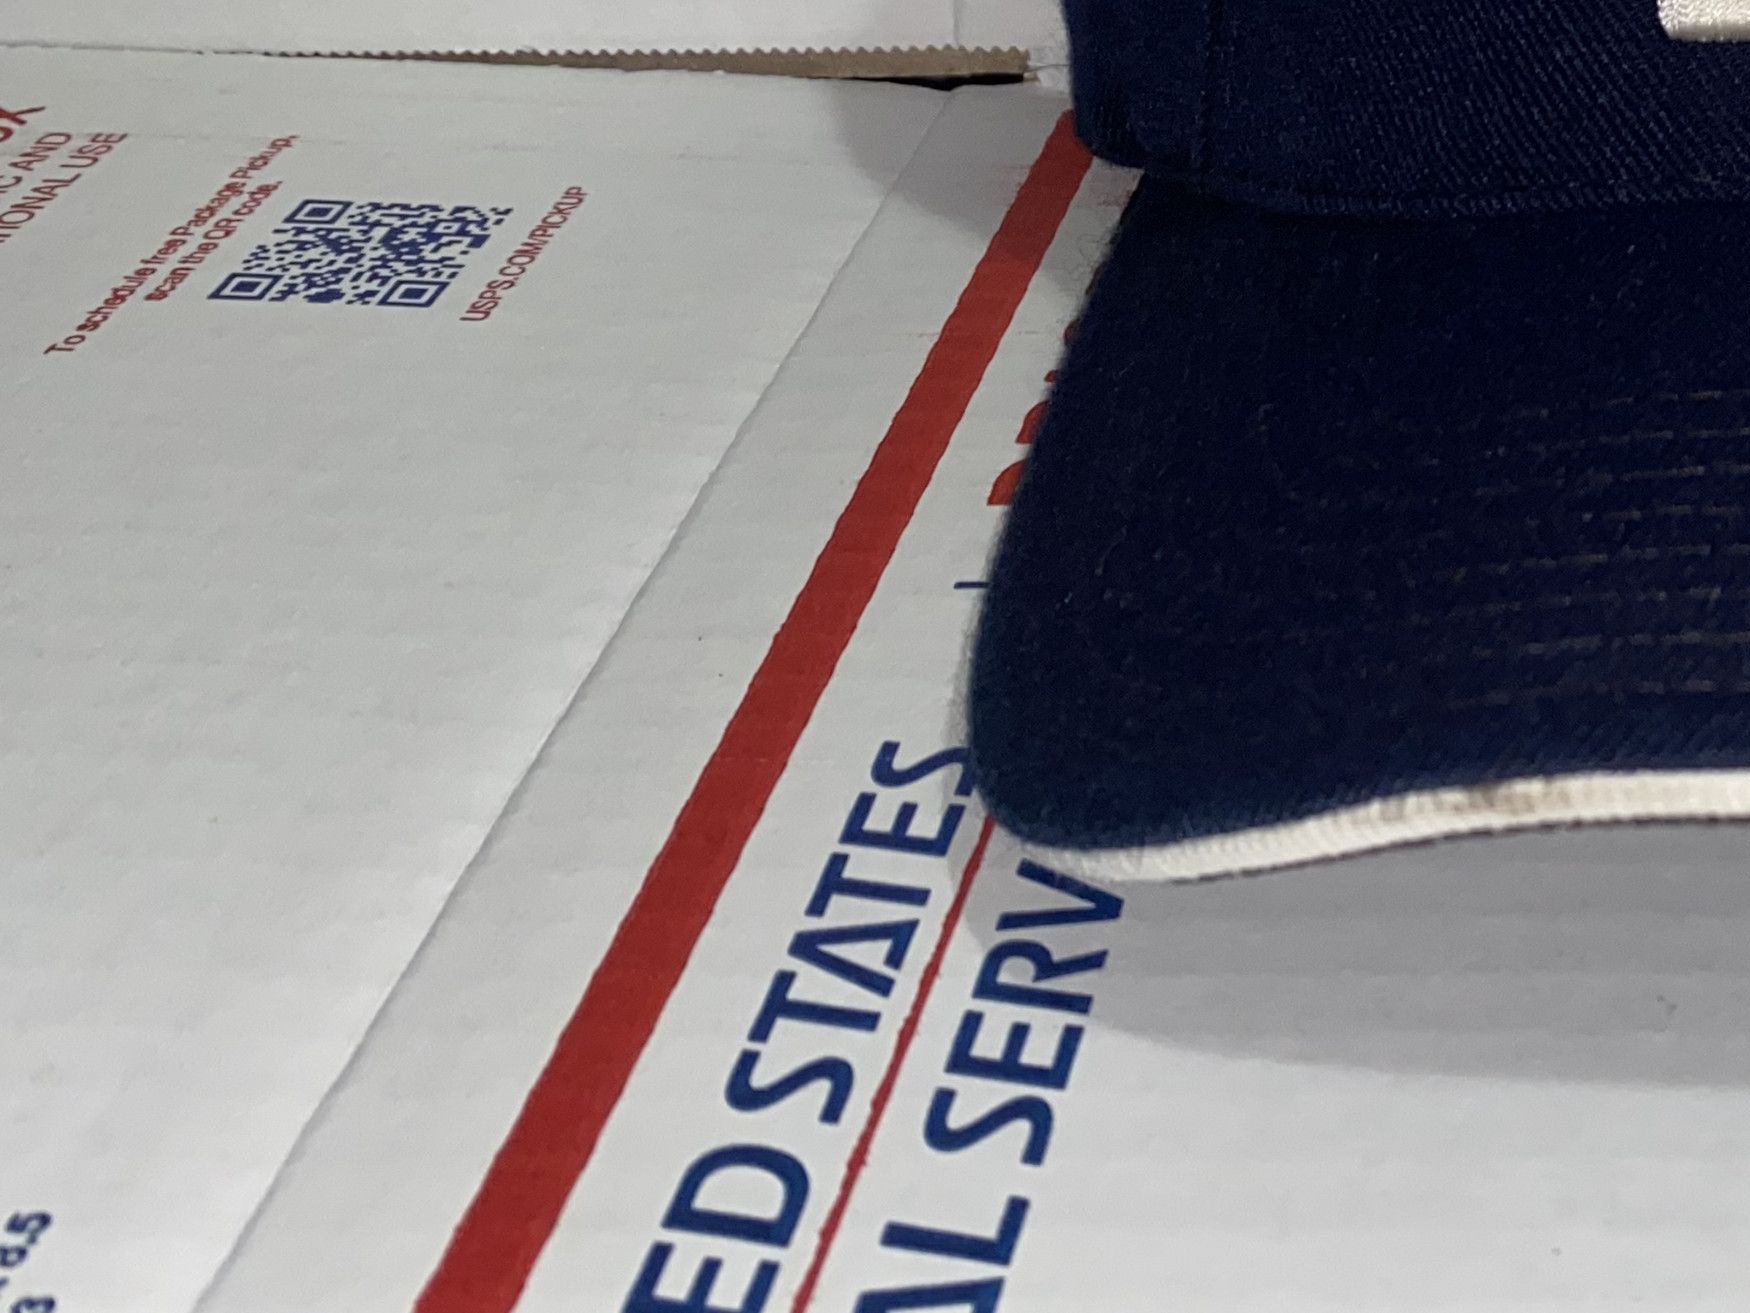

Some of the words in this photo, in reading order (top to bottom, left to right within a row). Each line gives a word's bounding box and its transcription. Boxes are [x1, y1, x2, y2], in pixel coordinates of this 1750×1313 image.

[8, 132, 73, 172] AND
[59, 132, 129, 169] USE
[43, 333, 87, 356] To
[75, 266, 158, 333] schedule
[139, 238, 188, 265] free
[169, 180, 248, 237] Package
[143, 265, 197, 302] scan
[177, 240, 220, 265] the
[202, 217, 245, 240] QR
[231, 180, 284, 217] code.
[458, 186, 589, 322] USPS.COM/PICKUP
[724, 740, 976, 1126] STATES
